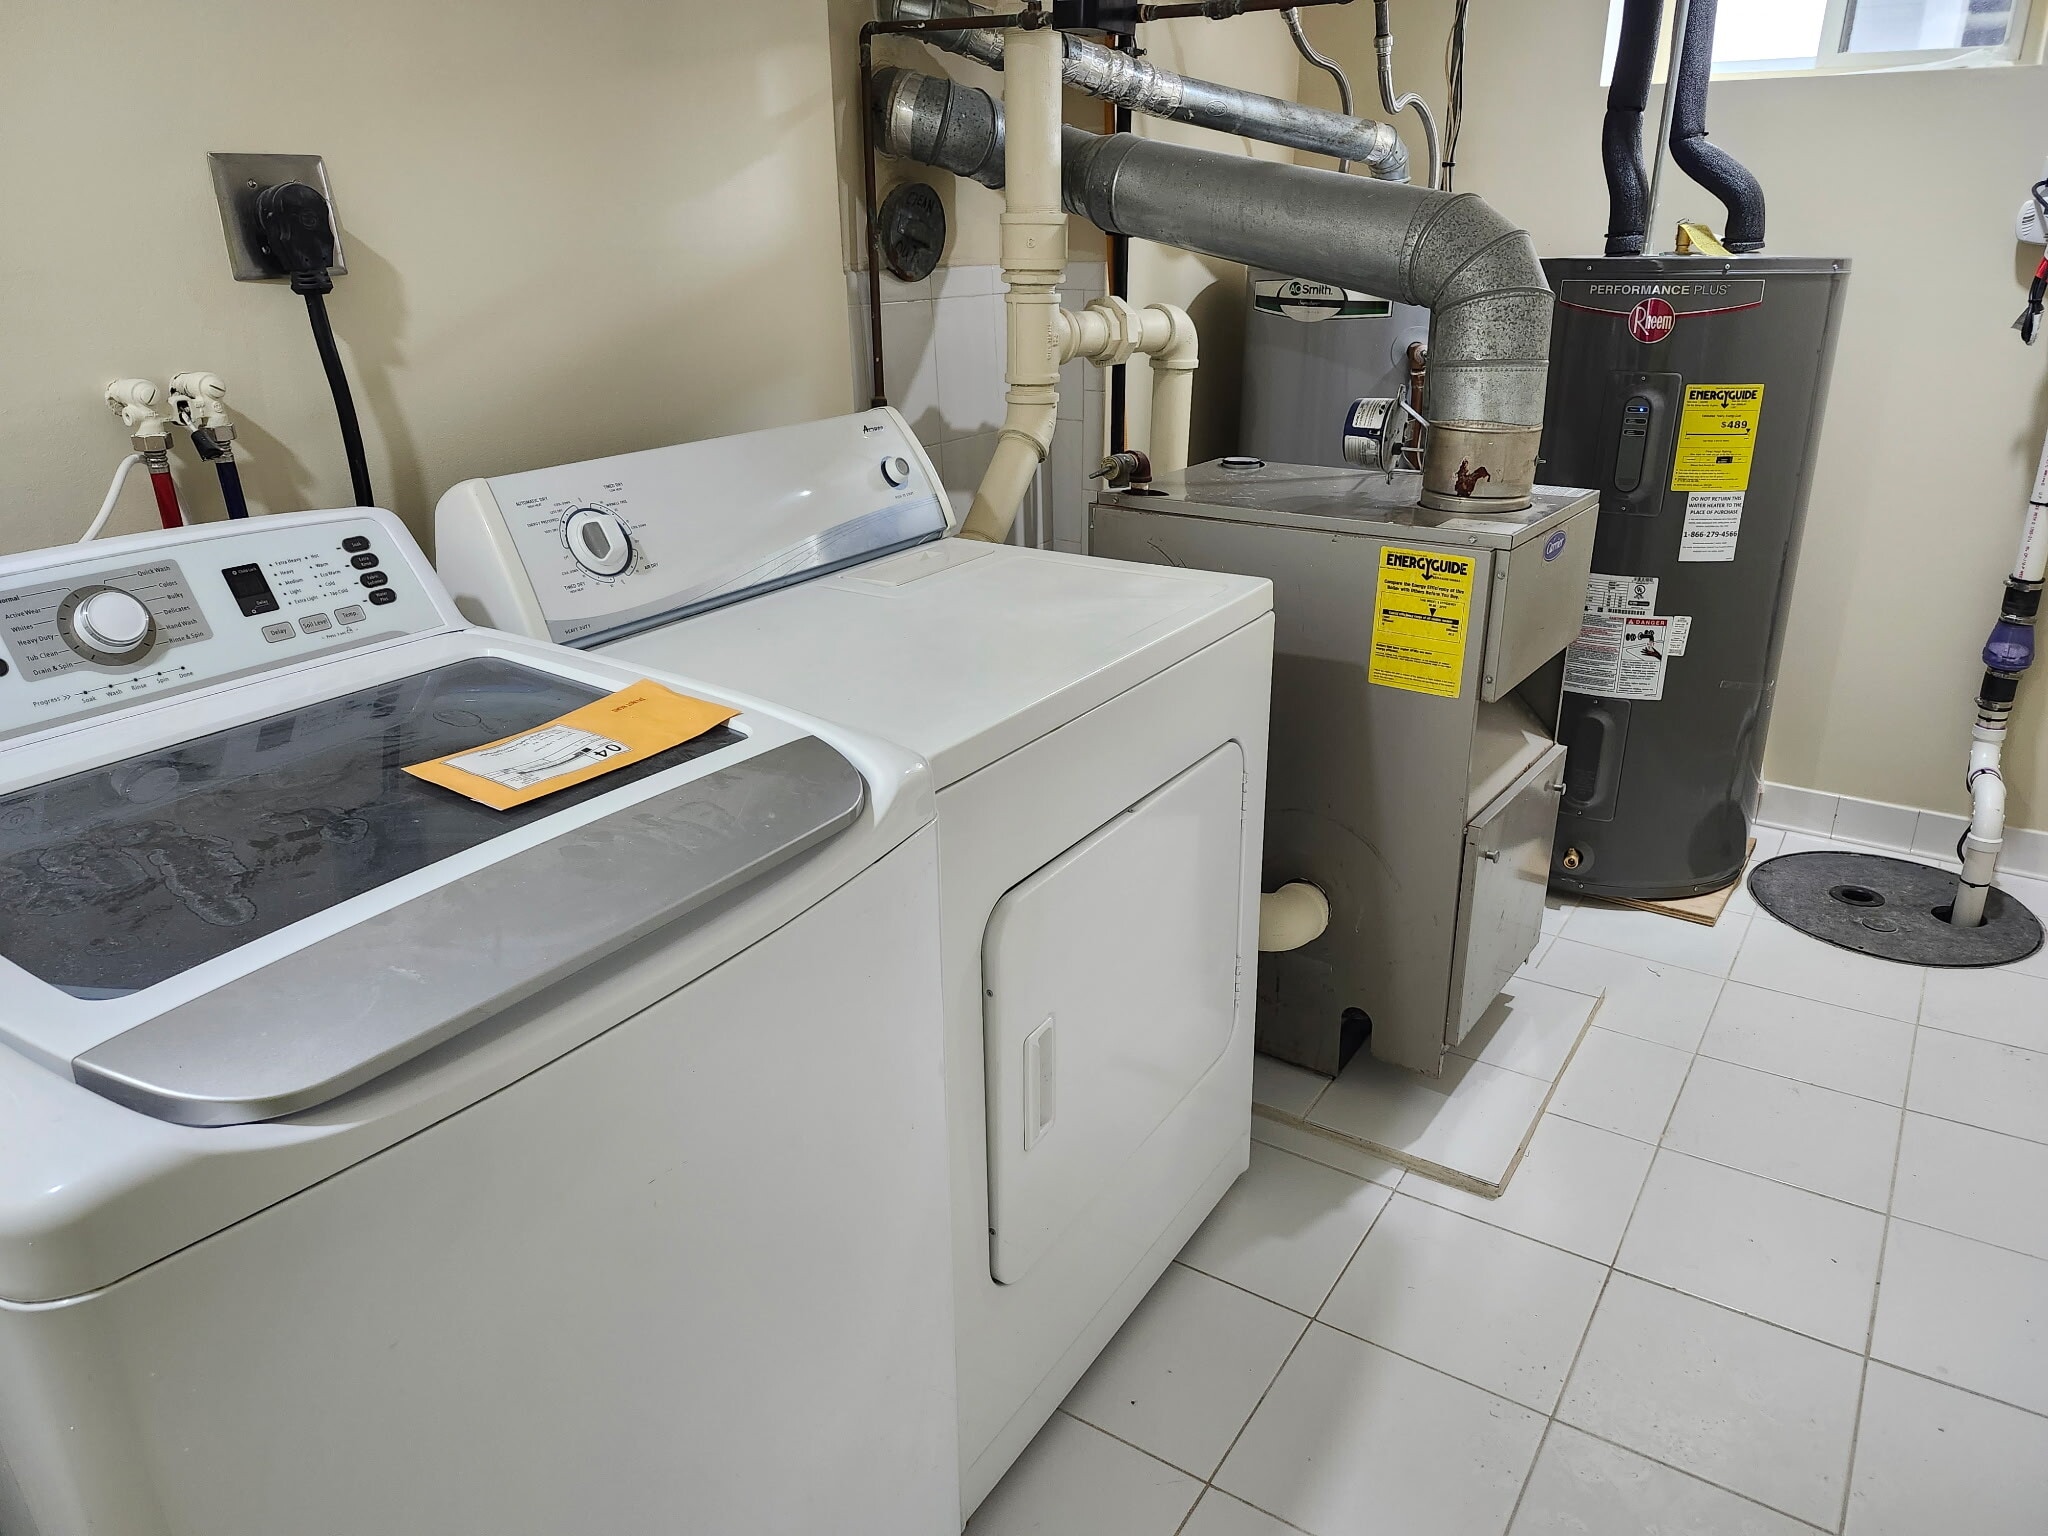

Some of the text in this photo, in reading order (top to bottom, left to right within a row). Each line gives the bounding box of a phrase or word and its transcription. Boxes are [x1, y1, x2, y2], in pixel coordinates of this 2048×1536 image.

[1302, 285, 1332, 295] Smith
[1590, 284, 1690, 295] PERFORMANCE
[1633, 299, 1673, 336] Rheem
[1689, 390, 1758, 400] ENERGYGUIDE
[1721, 420, 1748, 429] $489
[1386, 553, 1468, 576] ENERGYGUIDE
[137, 565, 171, 578] Quick Wash
[158, 579, 178, 589] Colors
[285, 577, 303, 587] Medium
[166, 592, 184, 601] Bulky
[5, 608, 42, 620] Active Wear
[163, 604, 191, 616] Delicates
[10, 623, 34, 633] Whites
[165, 618, 198, 630] Hand Wash
[303, 618, 328, 629] Soil Level
[168, 634, 185, 645] Rinse
[191, 630, 205, 641] Spin
[270, 627, 287, 637] Delay
[17, 634, 54, 648] Heavy Duty
[26, 650, 59, 663] Tub Clean
[32, 667, 52, 677] Drain
[58, 661, 74, 672] Spin
[156, 676, 170, 685] Spin
[178, 670, 194, 680] Done
[131, 681, 147, 692] Rinse
[105, 688, 123, 698] Wash
[32, 695, 61, 709] Progress
[81, 694, 96, 704] Soak
[593, 742, 622, 759] 04
